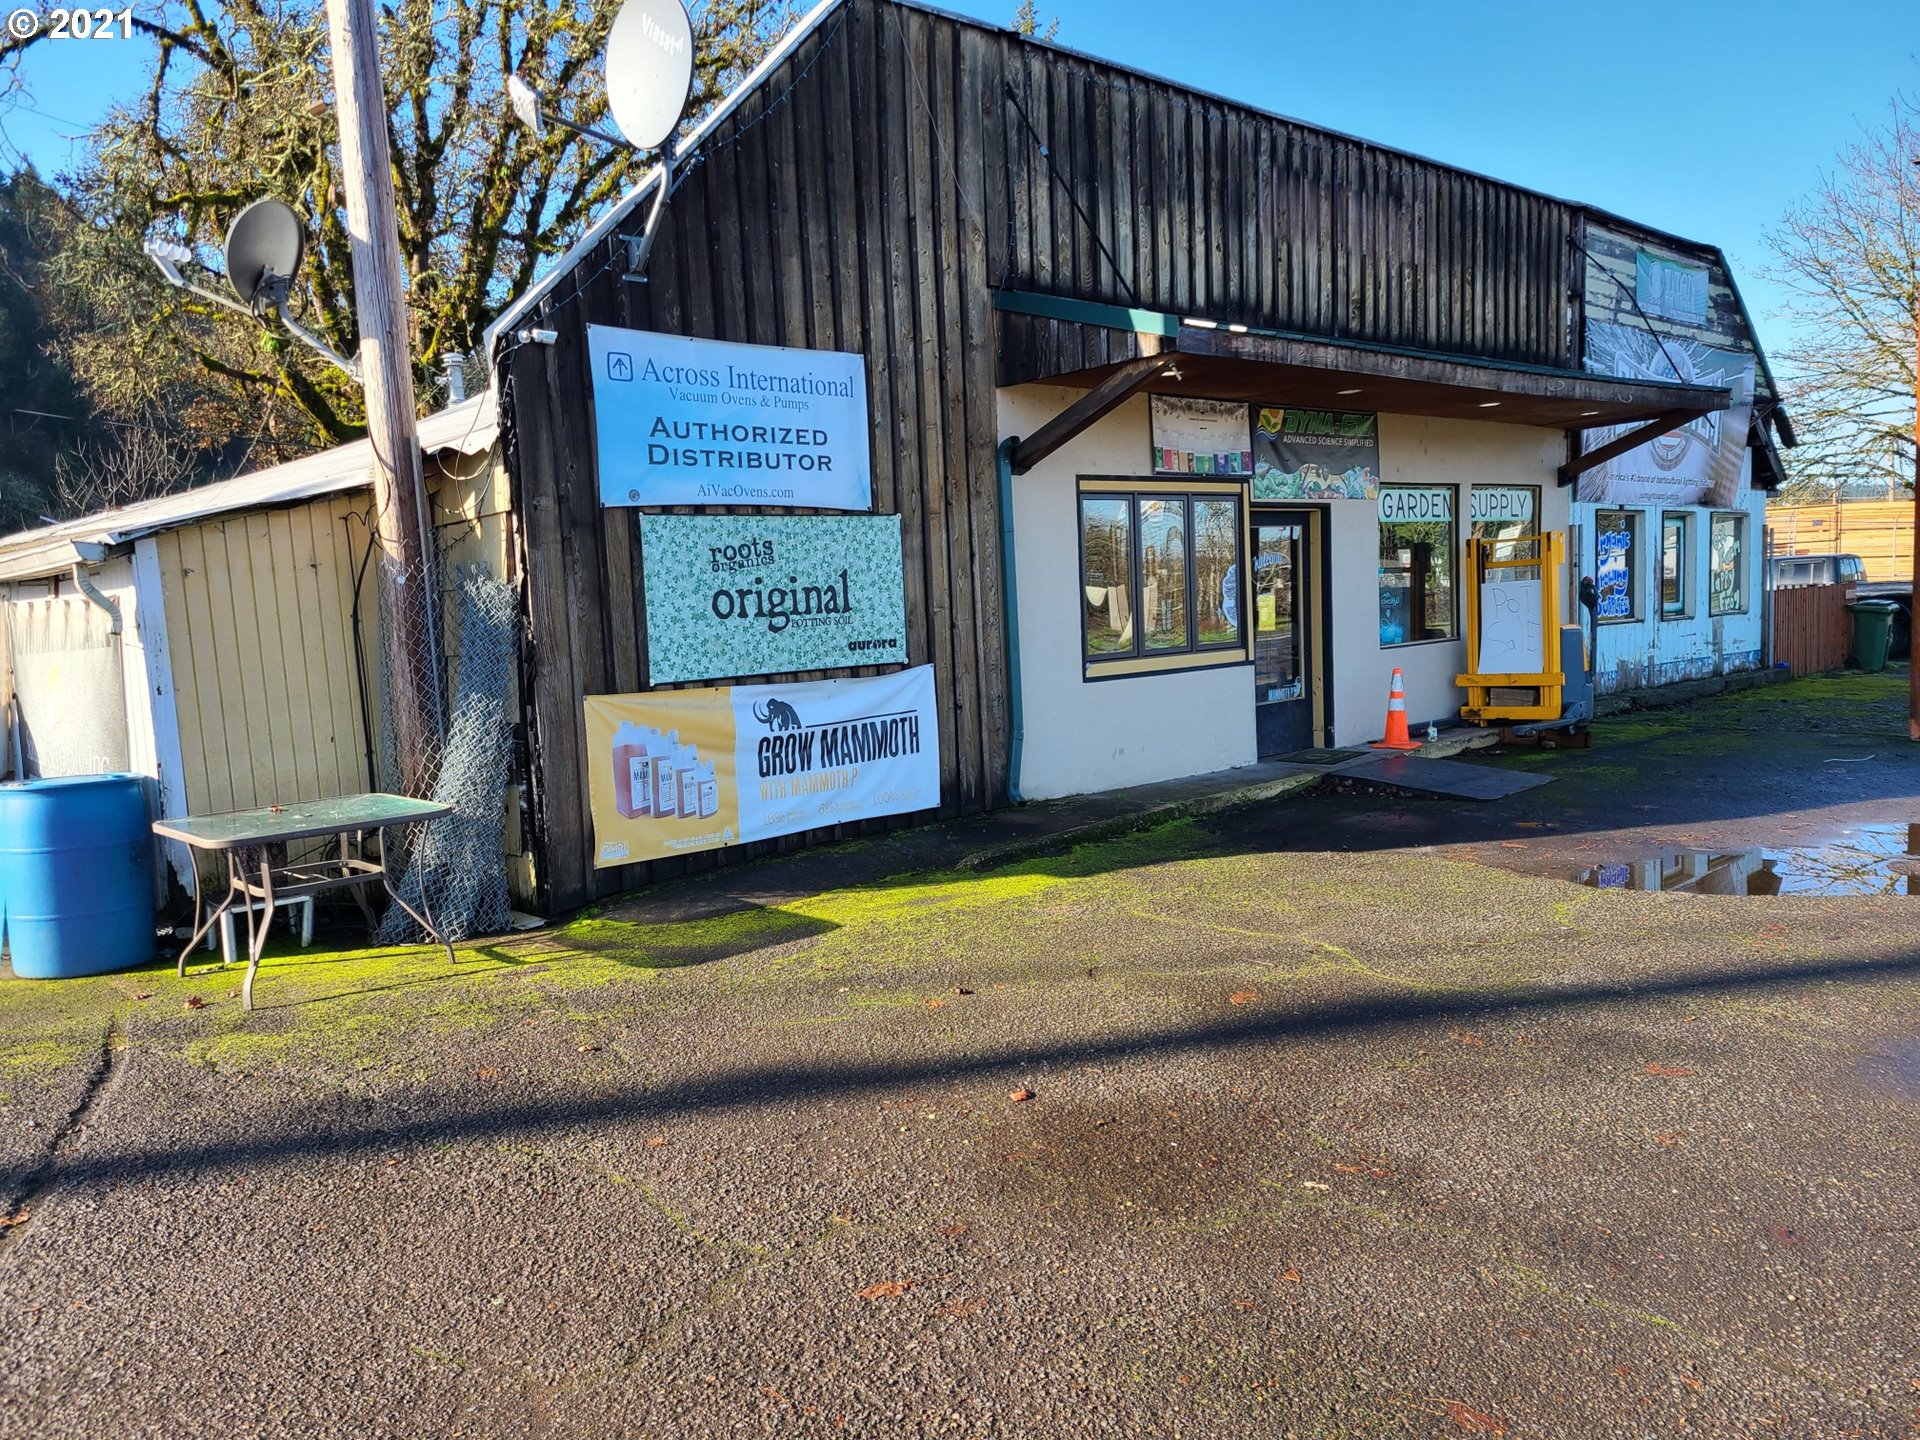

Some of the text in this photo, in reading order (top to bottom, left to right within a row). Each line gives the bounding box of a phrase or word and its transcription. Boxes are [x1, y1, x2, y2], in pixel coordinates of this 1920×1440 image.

[641, 357, 854, 398] Across International
[668, 387, 810, 413] Vacuum Ovens & Pumps
[649, 416, 828, 447] AUTHORIZED
[1282, 435, 1374, 448] ADVANCED SCIENCE SIMPLIFIED
[647, 443, 832, 472] DISTRIBUTOR
[697, 484, 794, 499] AiVacOvens.com
[1382, 492, 1452, 519] GARDEN
[1471, 493, 1528, 519] SUPPLY
[709, 537, 774, 564] roots
[711, 554, 775, 573] organics
[711, 568, 853, 633] original
[791, 615, 854, 628] POTTING SOIL
[848, 637, 897, 651] aurora
[758, 715, 920, 777] GROW MAMMOTH
[760, 768, 858, 802] WITH MAMMOTH P
